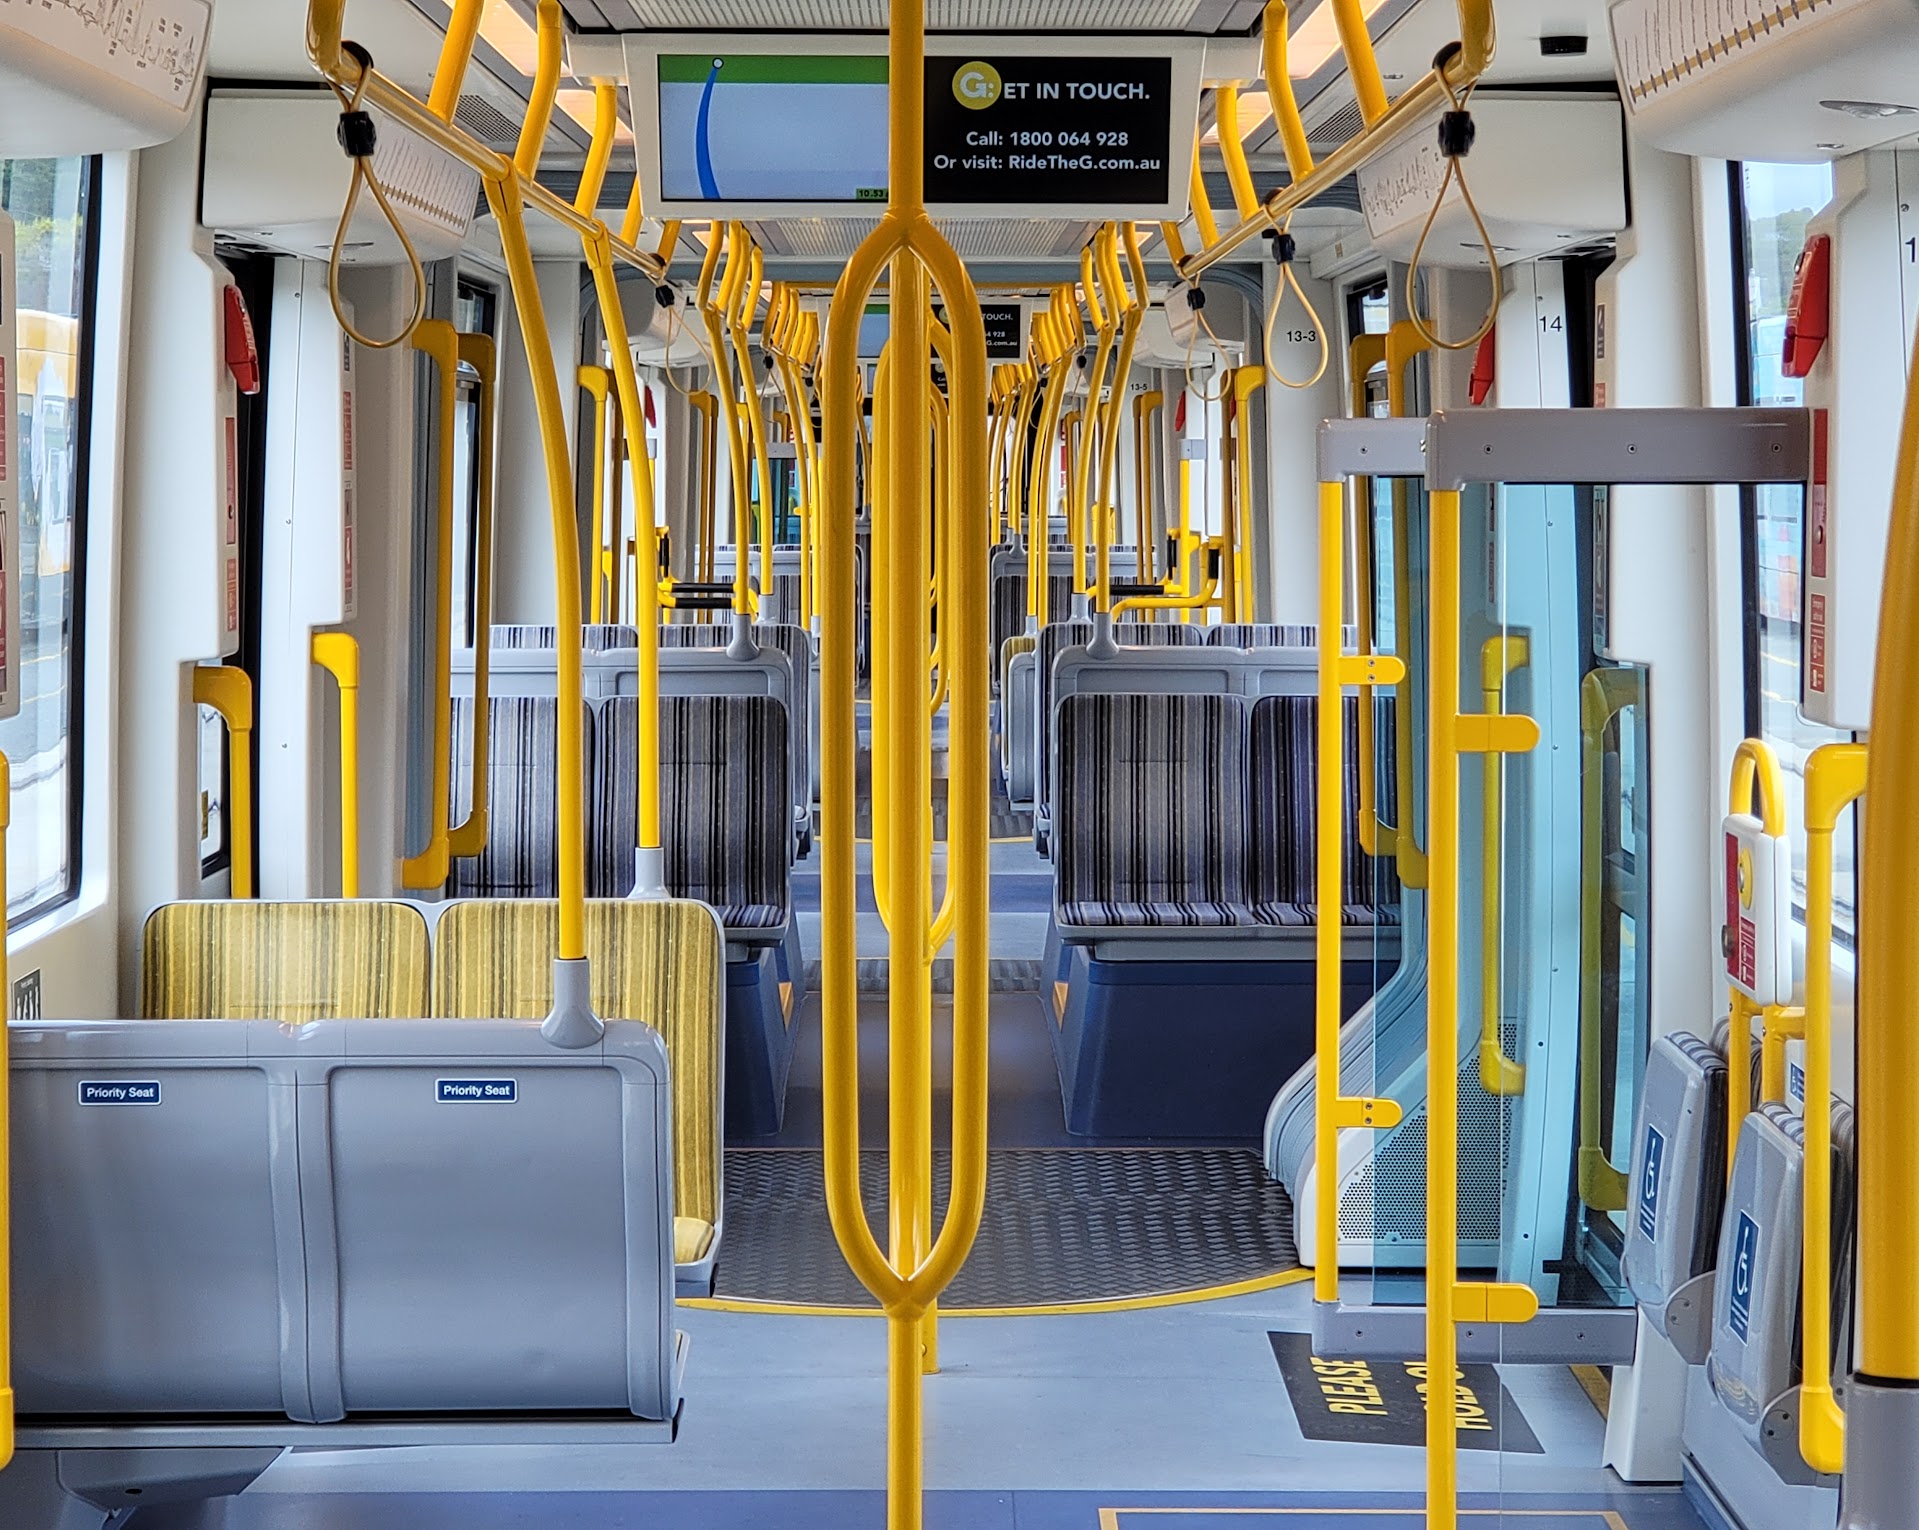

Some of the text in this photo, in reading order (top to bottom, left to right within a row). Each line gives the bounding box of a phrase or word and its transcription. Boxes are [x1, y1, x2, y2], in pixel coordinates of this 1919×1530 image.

[1036, 83, 1060, 99] IN
[1066, 83, 1150, 100] TOUCH.
[966, 131, 1129, 146] Call: 1800 064 928
[933, 154, 1161, 170] Or visit: RideTheG.com.au
[1539, 315, 1563, 333] 14
[1287, 330, 1316, 343] 13-3
[1130, 383, 1148, 391] 13-5
[86, 1087, 154, 1100] Priority Seat
[443, 1085, 510, 1098] Priority Seat
[1310, 1356, 1389, 1416] PLEASE
